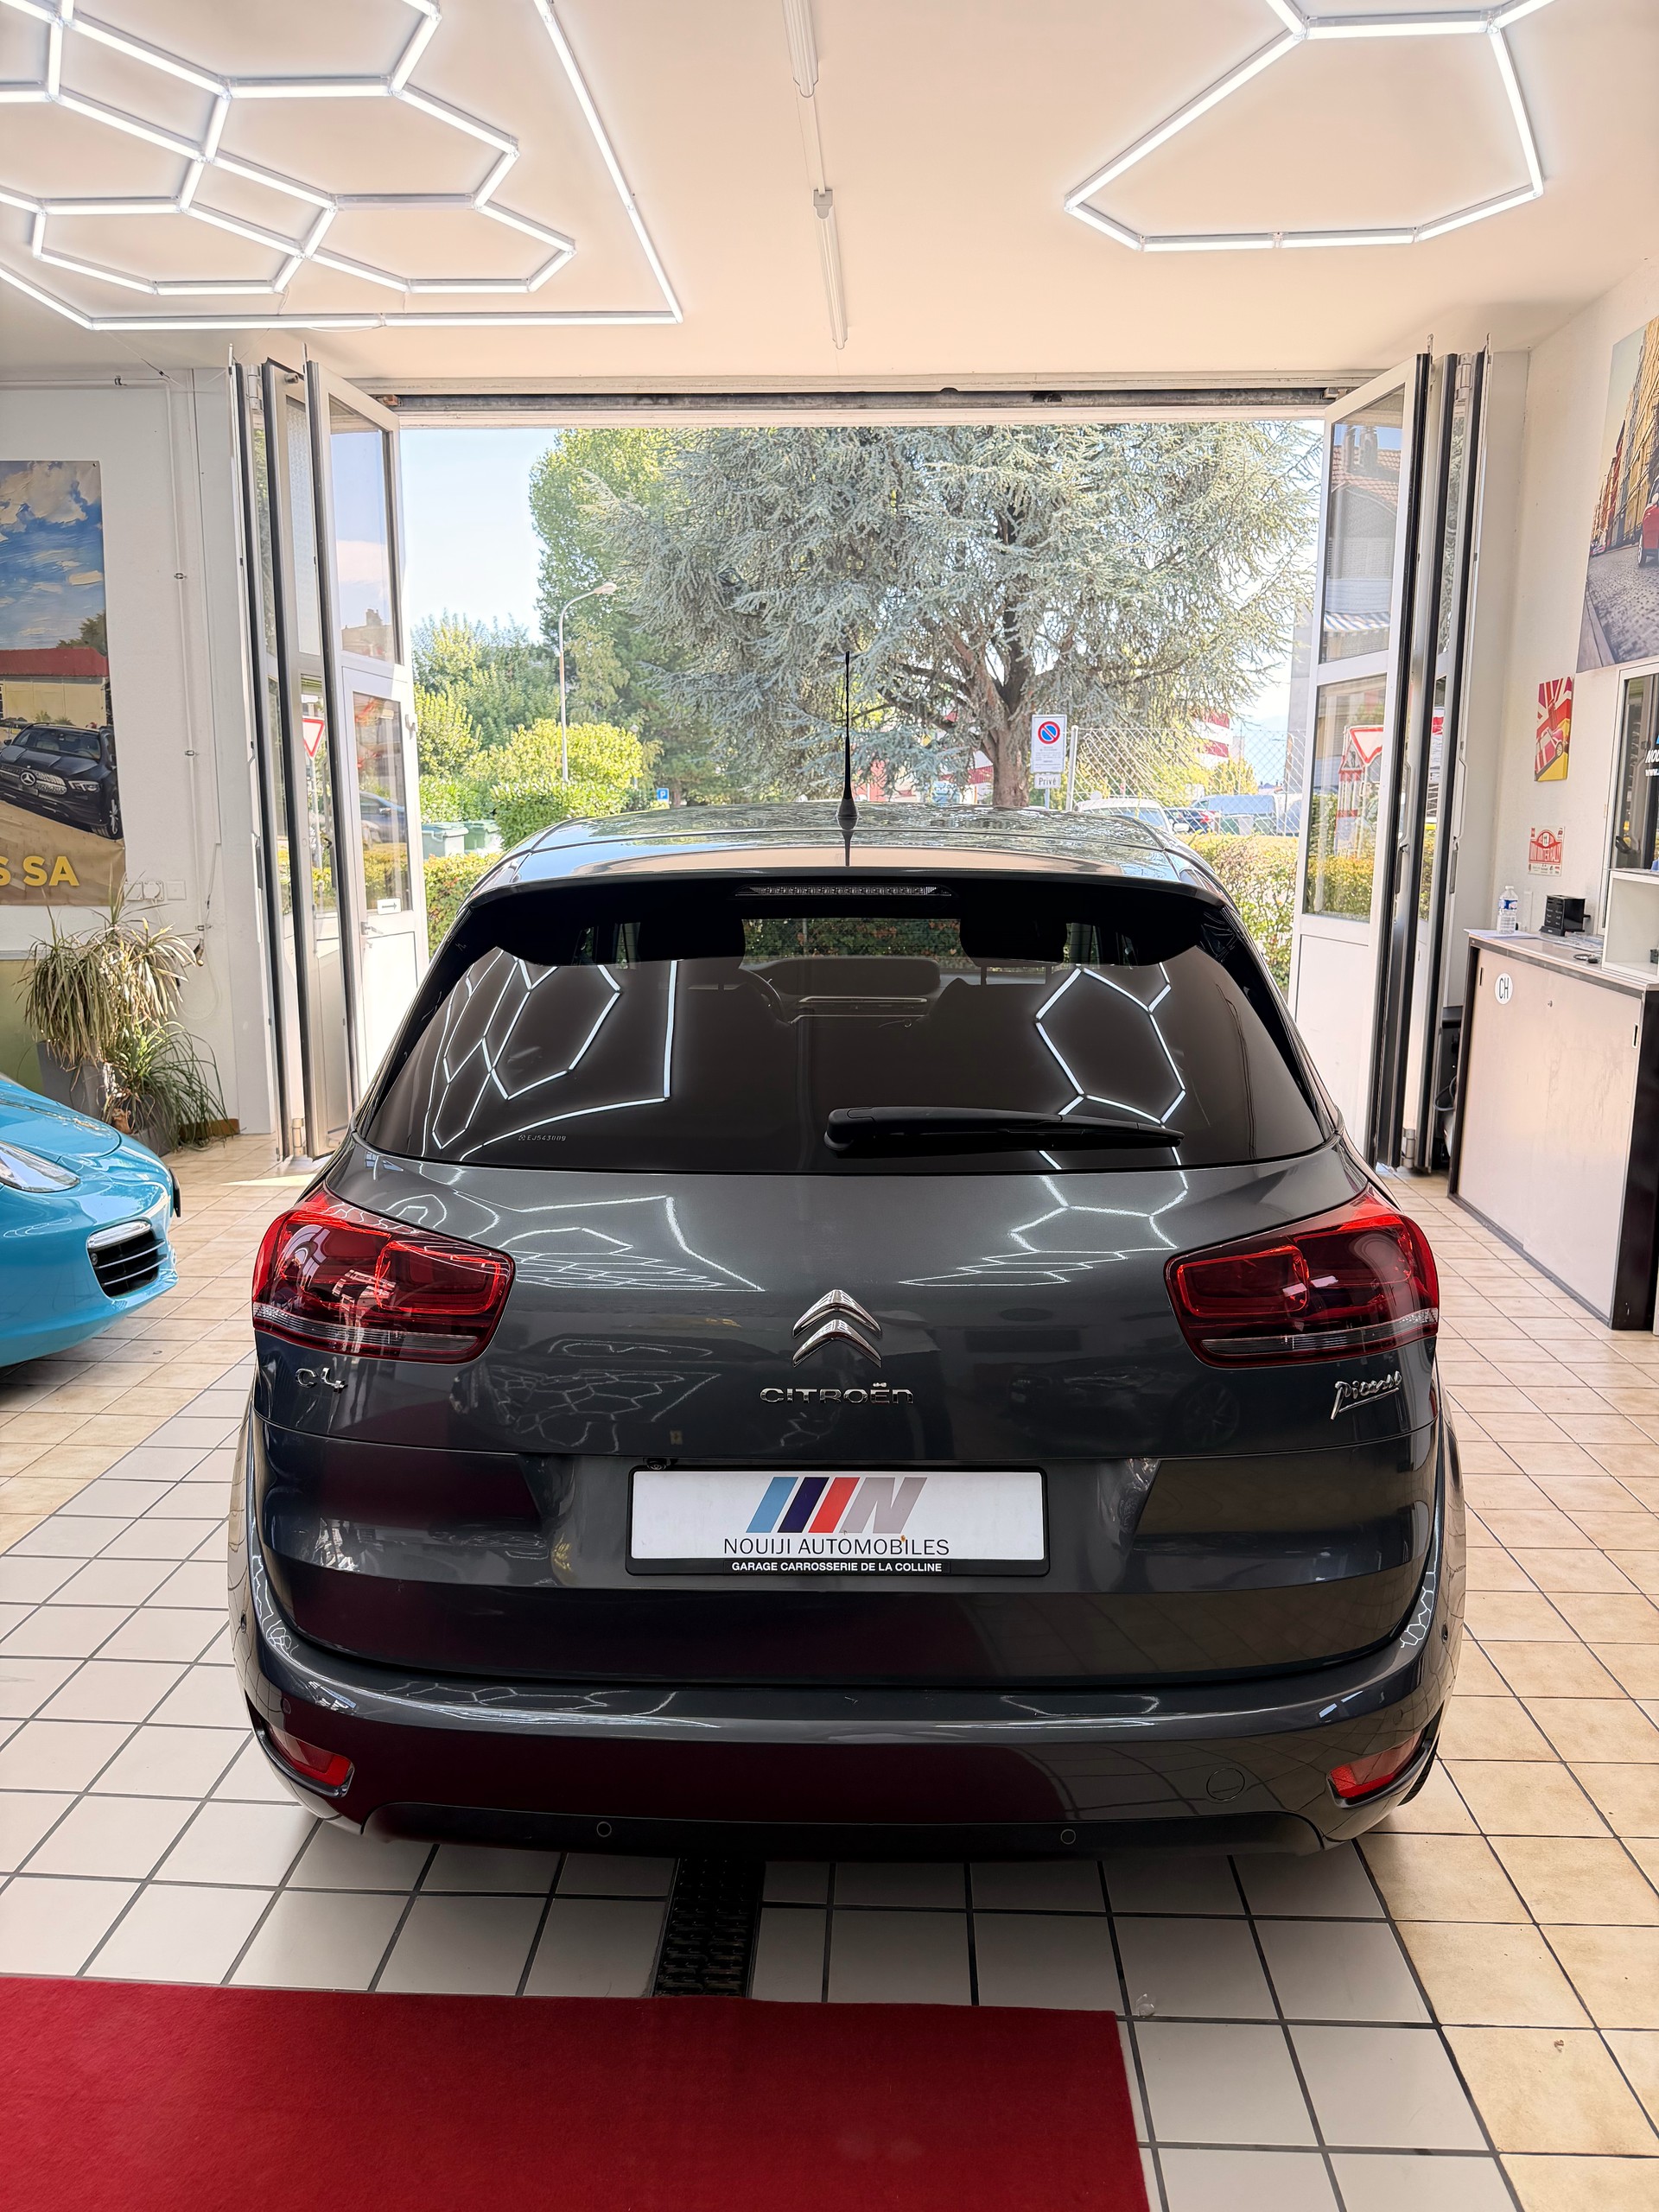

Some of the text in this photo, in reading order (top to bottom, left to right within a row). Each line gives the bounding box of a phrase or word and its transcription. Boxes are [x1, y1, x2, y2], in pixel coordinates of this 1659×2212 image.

[1039, 776, 1057, 785] Privé
[23, 855, 79, 887] SA
[1498, 977, 1510, 1000] CH
[296, 1367, 345, 1390] C4
[1330, 1370, 1402, 1421] Picasso
[724, 1538, 950, 1555] NOUIJI AUTOMOBILES
[731, 1562, 943, 1572] GARAGE CARROSSERIE DE LA COLLINE
